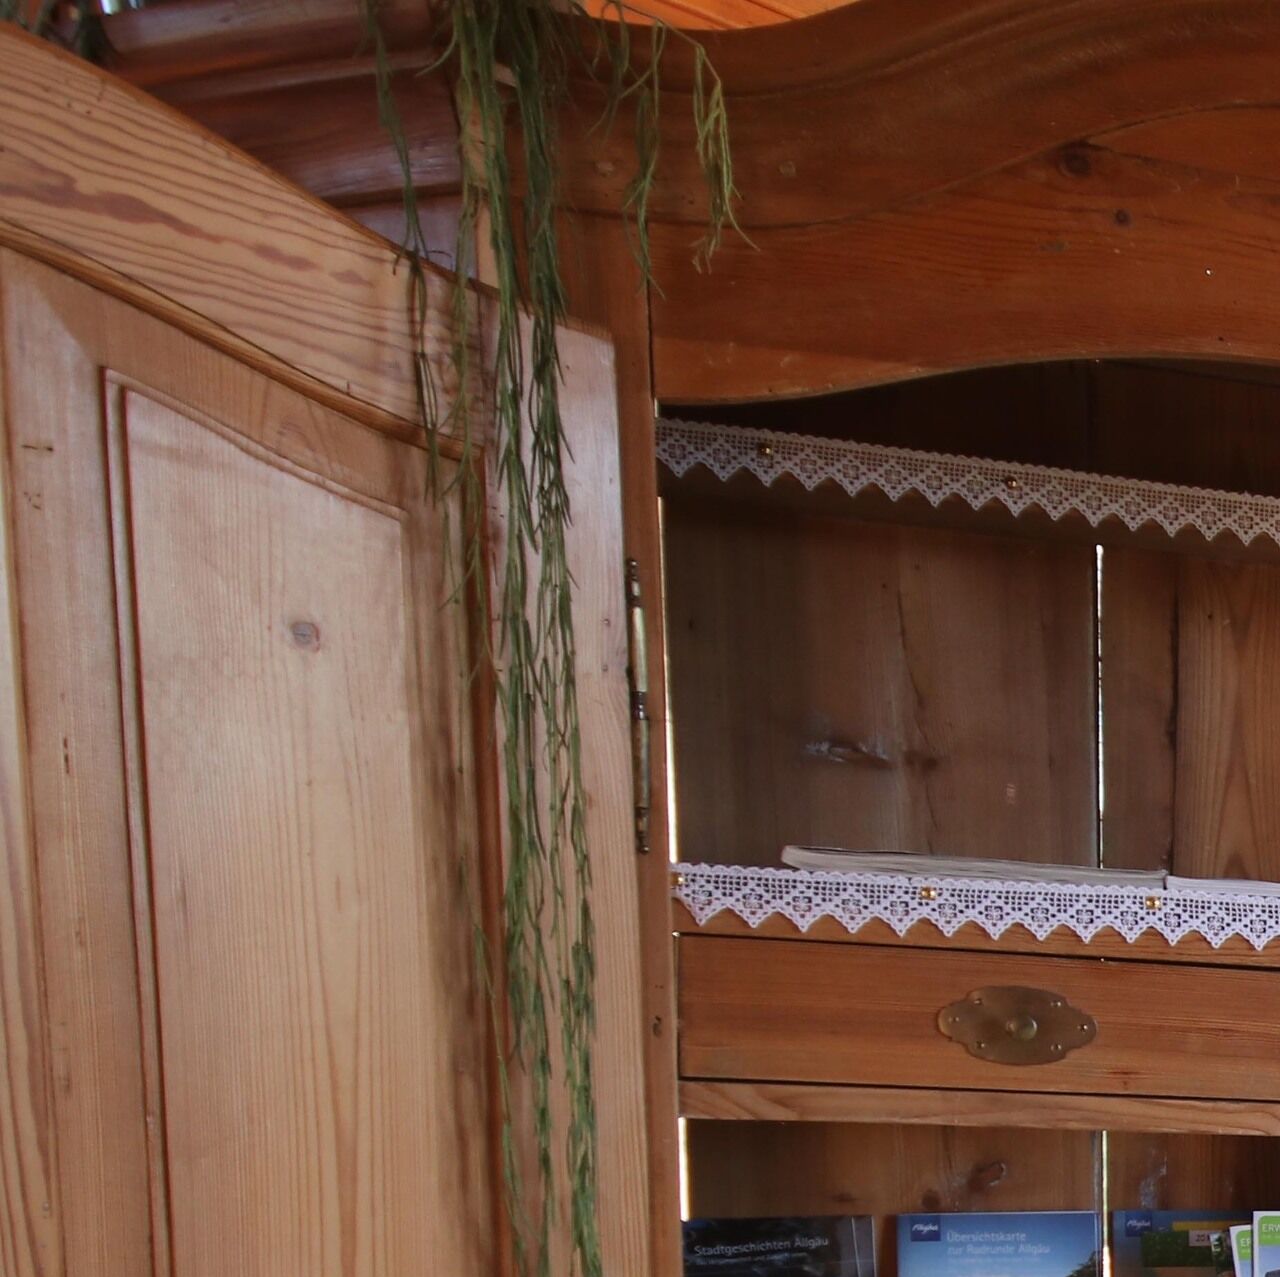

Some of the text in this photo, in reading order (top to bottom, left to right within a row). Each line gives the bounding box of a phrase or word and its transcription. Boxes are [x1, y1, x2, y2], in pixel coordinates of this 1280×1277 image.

[946, 1230, 1027, 1243] Übersichtskarte
[694, 1235, 829, 1257] Stadtgeschichten Allgäu
